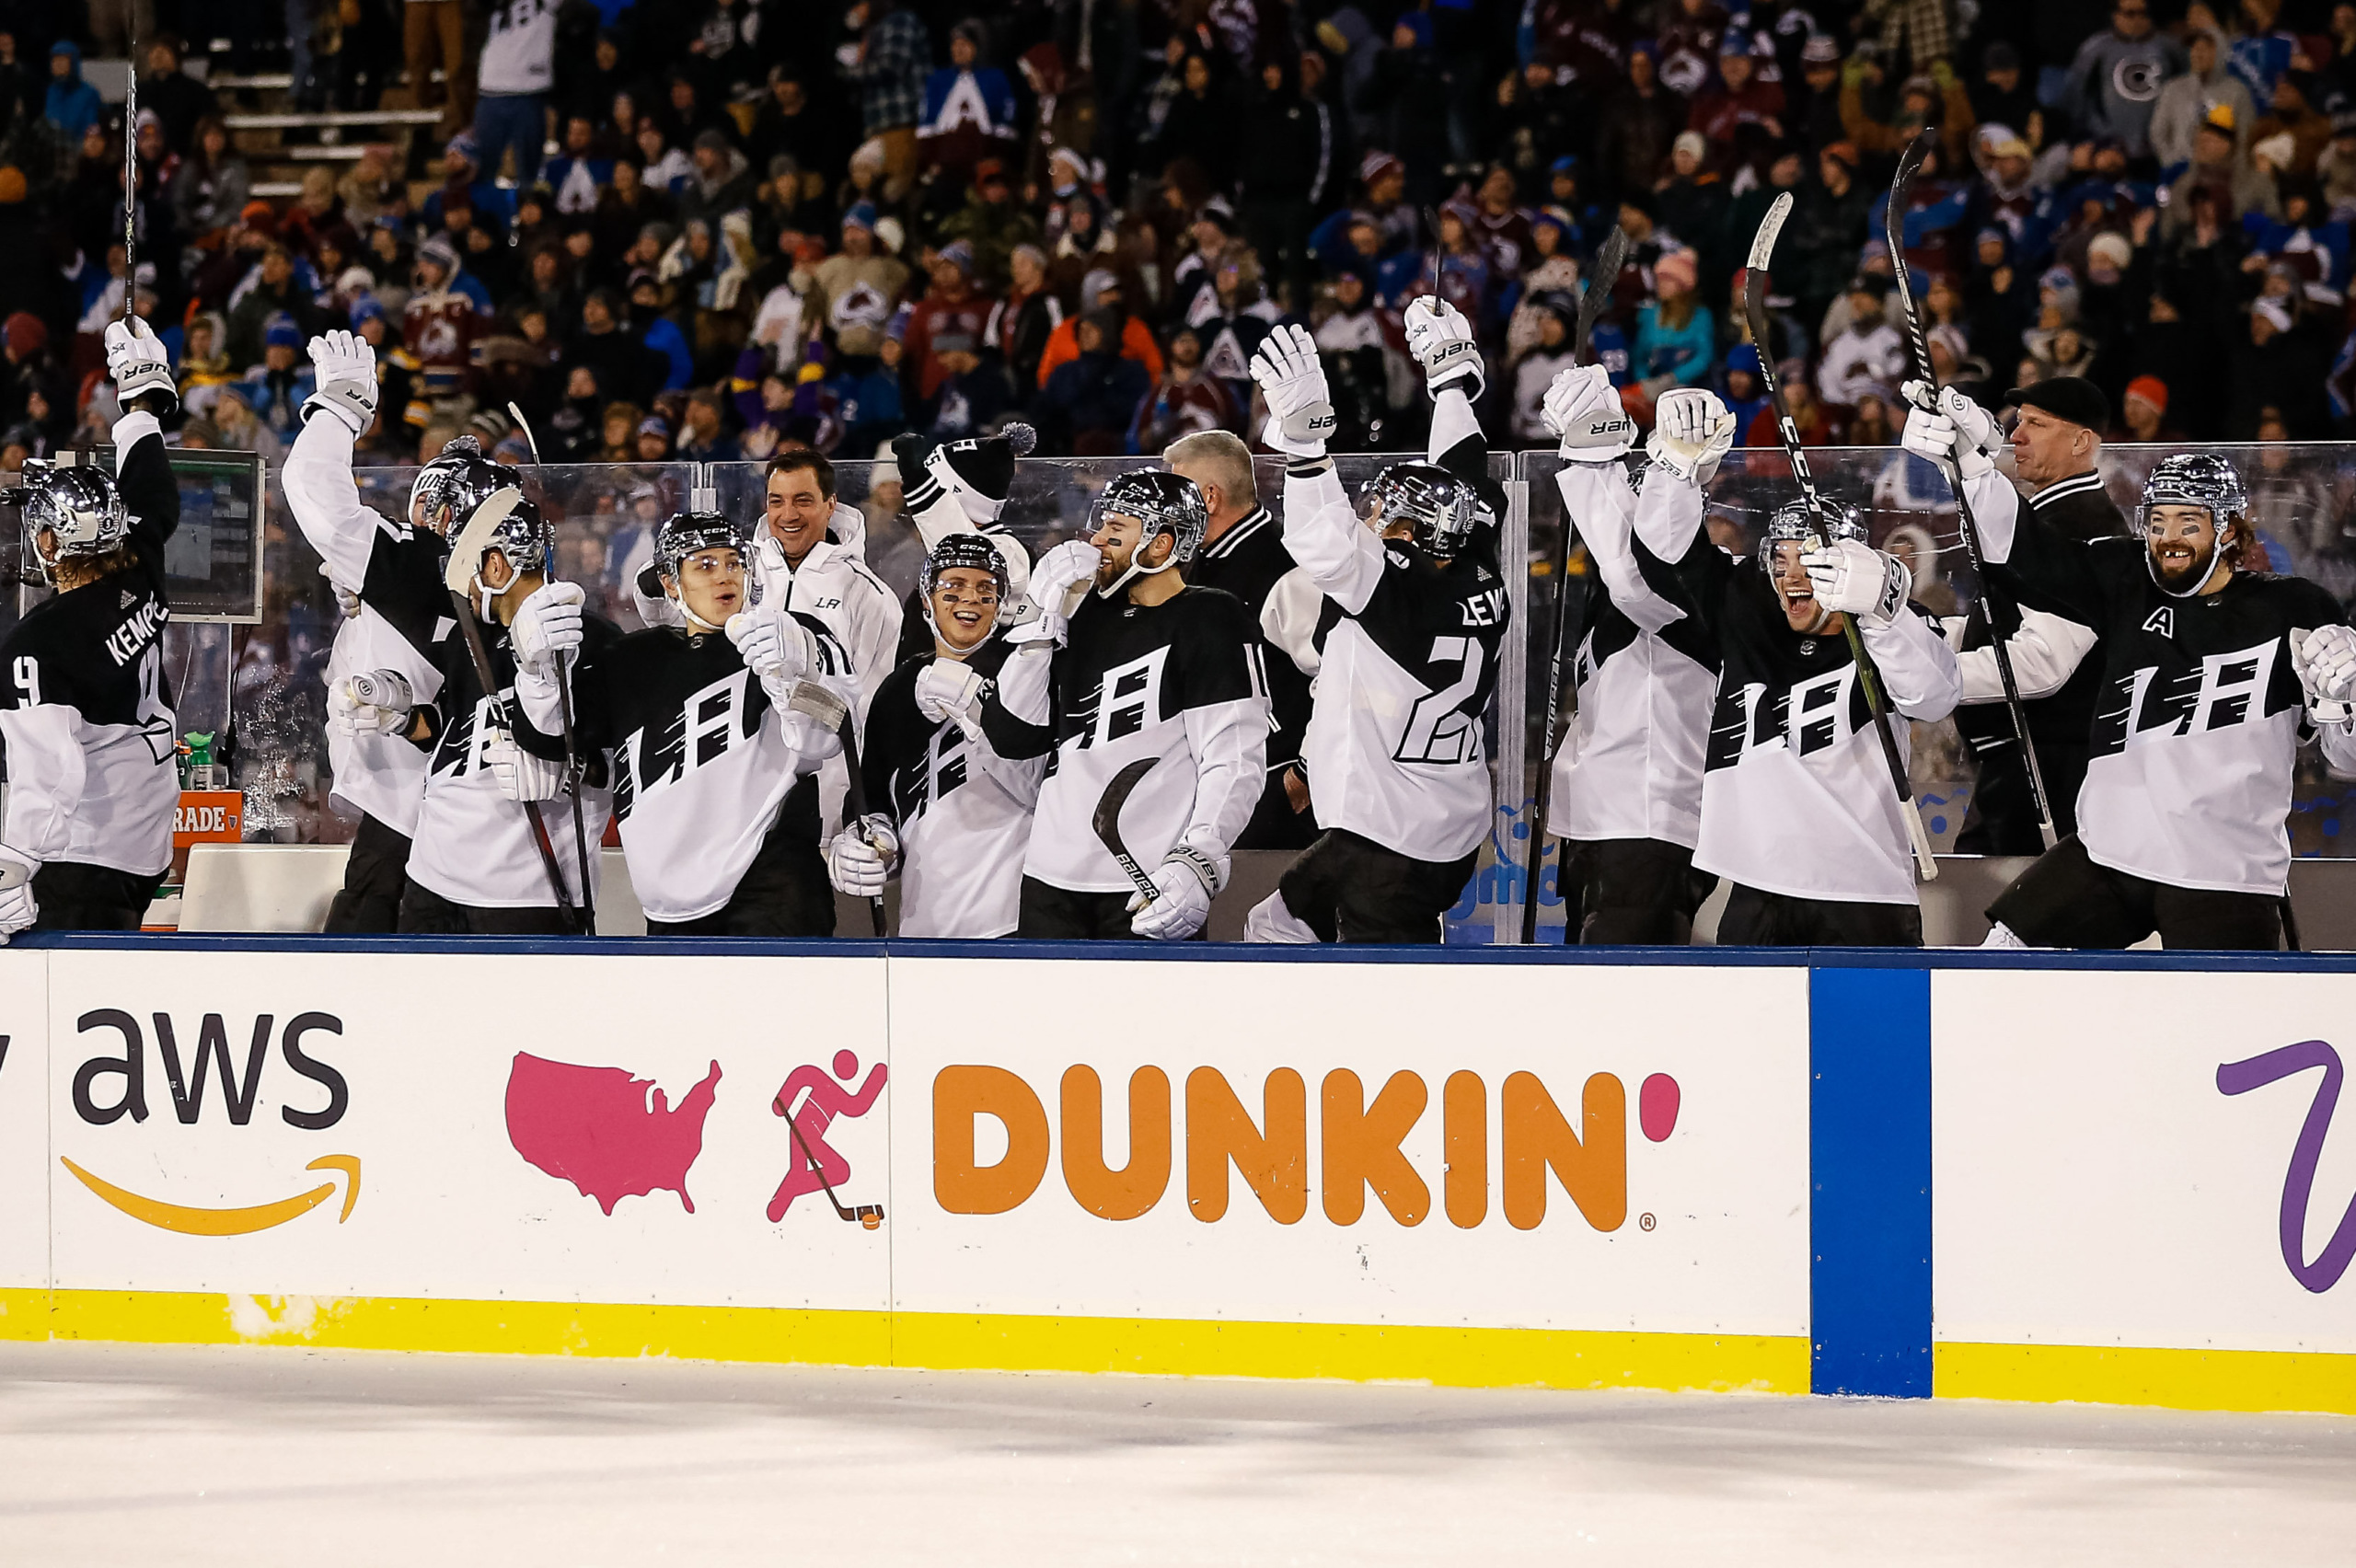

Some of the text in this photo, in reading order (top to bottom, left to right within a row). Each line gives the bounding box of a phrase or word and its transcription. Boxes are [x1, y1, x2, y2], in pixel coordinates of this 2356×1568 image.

[345, 388, 375, 414] ER
[1759, 361, 1774, 392] CCM
[1658, 459, 1681, 477] CCM
[1781, 416, 1822, 512] CCM
[702, 526, 729, 536] CCM
[959, 543, 987, 552] CCM
[105, 590, 169, 667] KEMPE
[814, 596, 841, 611] LA
[2142, 605, 2174, 640] A
[1543, 657, 1561, 762] BAUER
[1736, 661, 1858, 767] LA
[2121, 635, 2282, 753] LA
[617, 666, 755, 802] LA
[1114, 853, 1159, 899] BAUER
[72, 1008, 349, 1130] aws
[932, 1062, 1681, 1233] DUNKIN'
